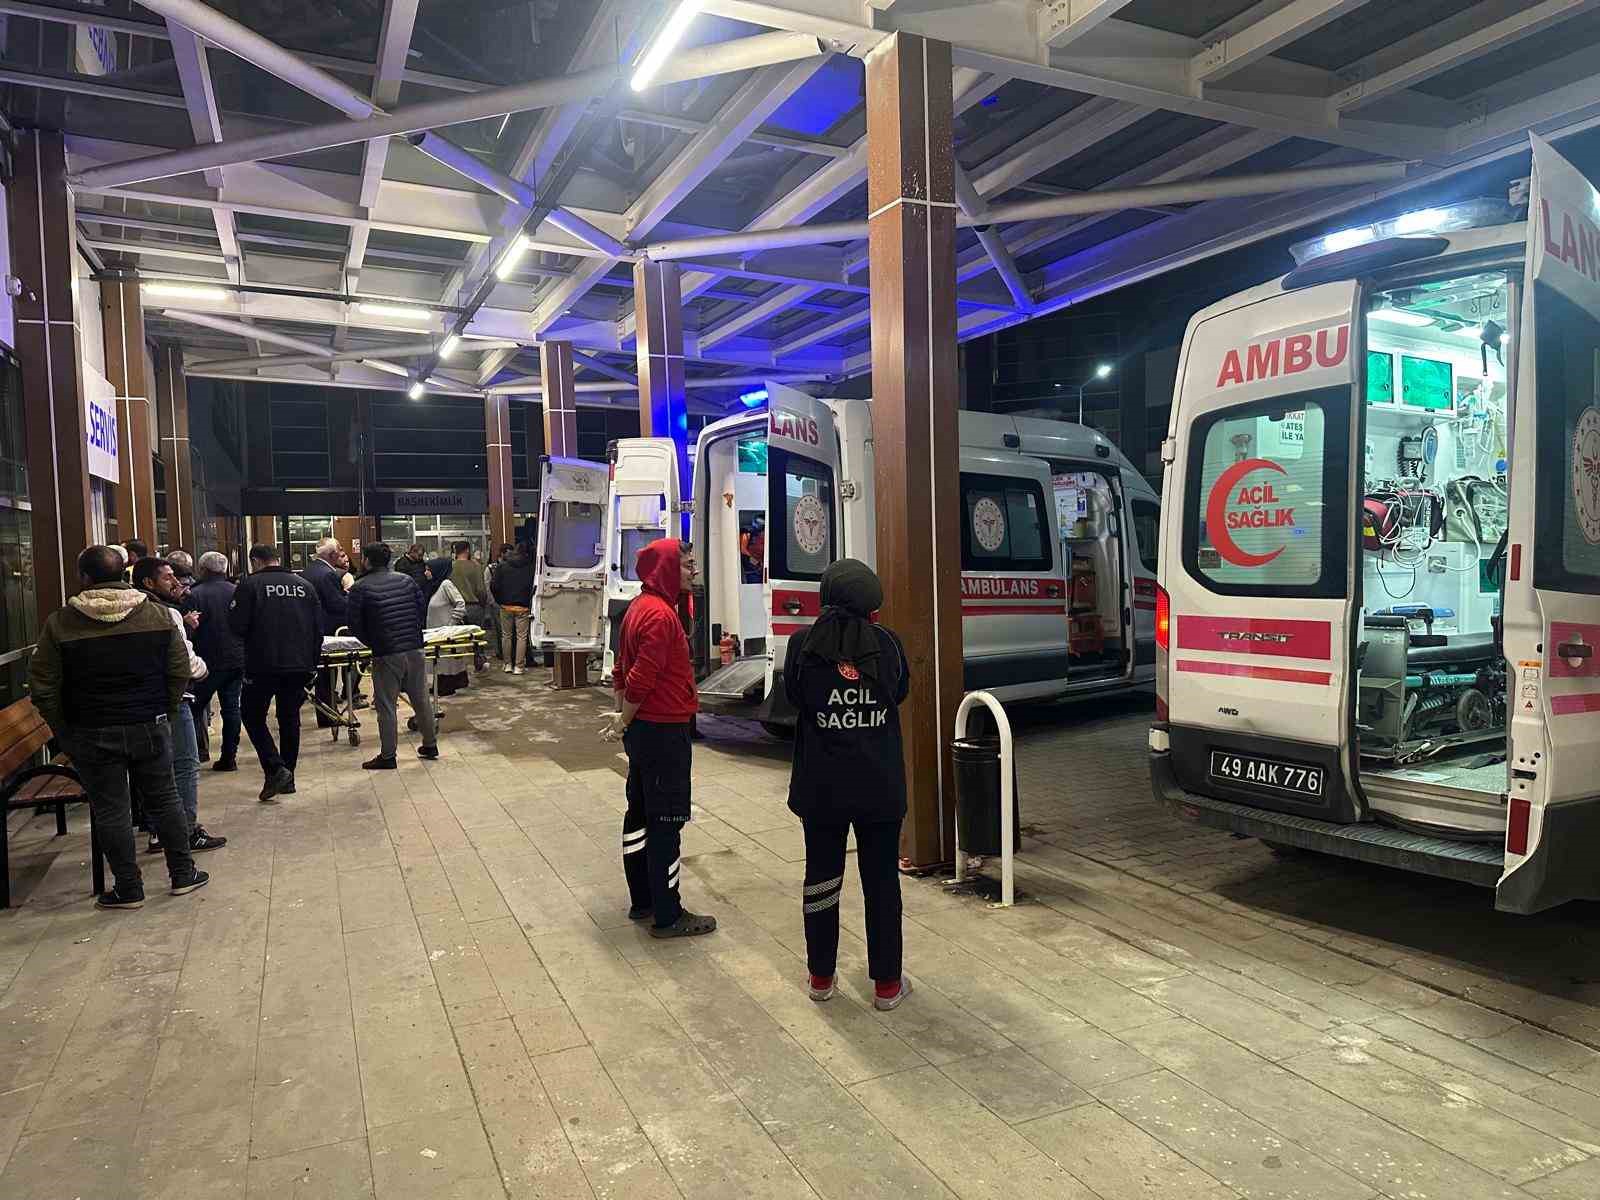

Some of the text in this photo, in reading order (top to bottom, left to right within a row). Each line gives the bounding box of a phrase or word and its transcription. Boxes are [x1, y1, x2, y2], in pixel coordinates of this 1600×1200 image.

[1216, 325, 1349, 388] AMBU
[90, 401, 116, 456] SERVİS
[770, 409, 818, 445] LANS
[1227, 506, 1296, 529] SAĞLIK
[960, 578, 1039, 595] AMBULANS
[816, 708, 888, 729] SAĞLIK
[1221, 757, 1319, 791] 49 AAK 776
